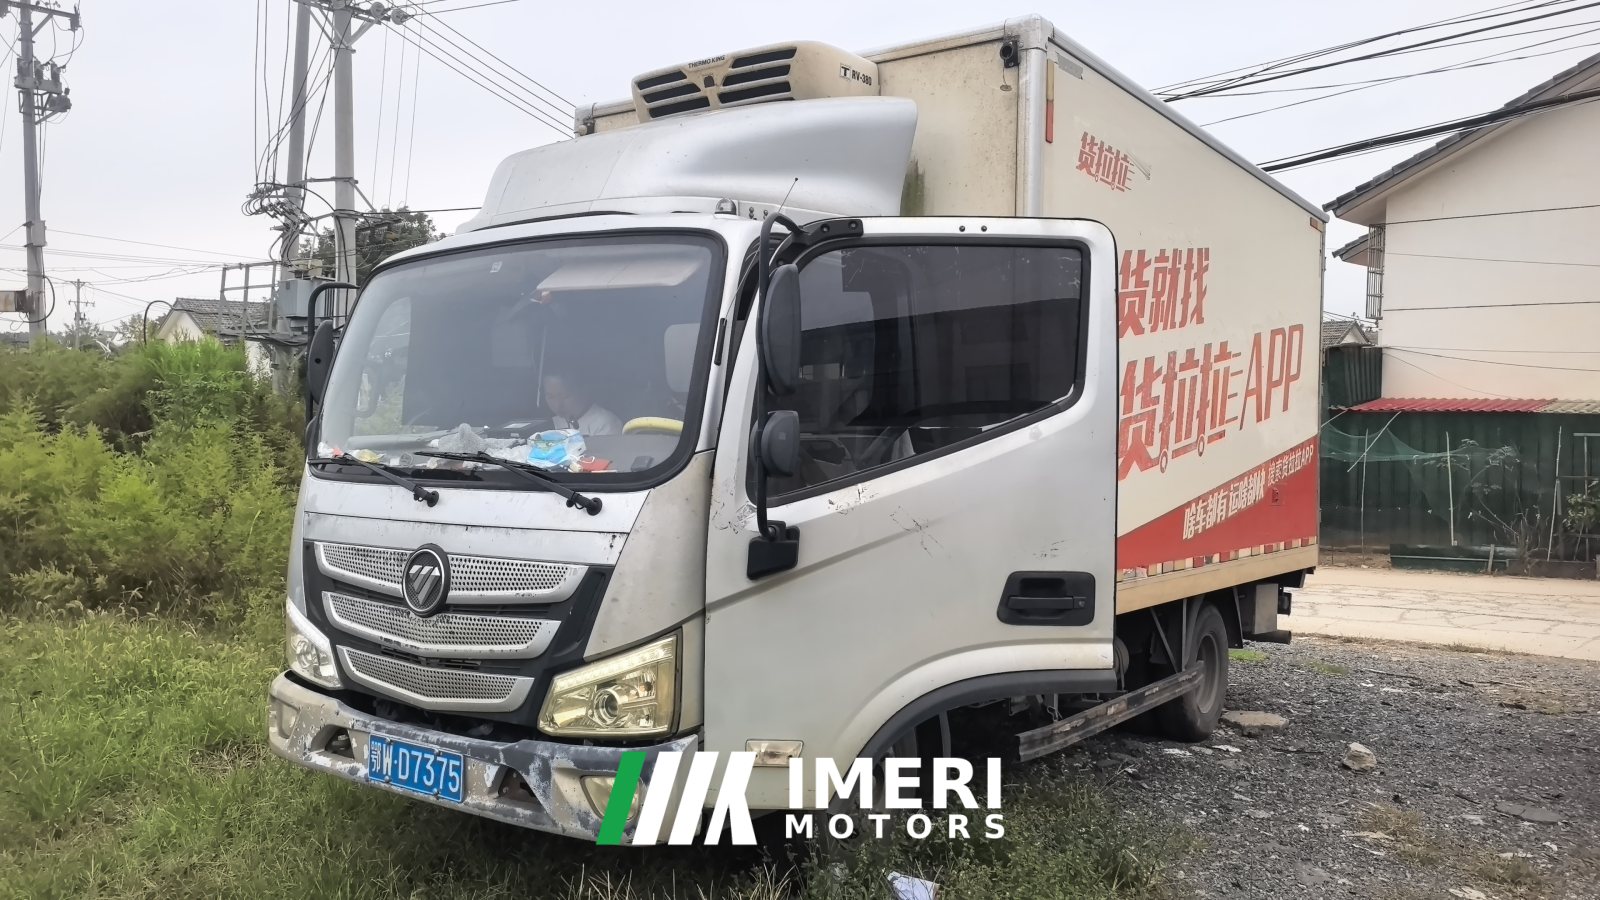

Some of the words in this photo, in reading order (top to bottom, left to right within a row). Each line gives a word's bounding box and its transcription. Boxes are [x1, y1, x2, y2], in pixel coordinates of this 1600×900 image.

[688, 58, 711, 69] THERMO
[711, 54, 726, 64] KING
[852, 70, 872, 86] RV-380
[1076, 131, 1133, 192] 货拉拉
[1118, 248, 1210, 339] 货就找
[1183, 489, 1229, 540] 啥车都有
[1228, 469, 1266, 517] 运啥都快
